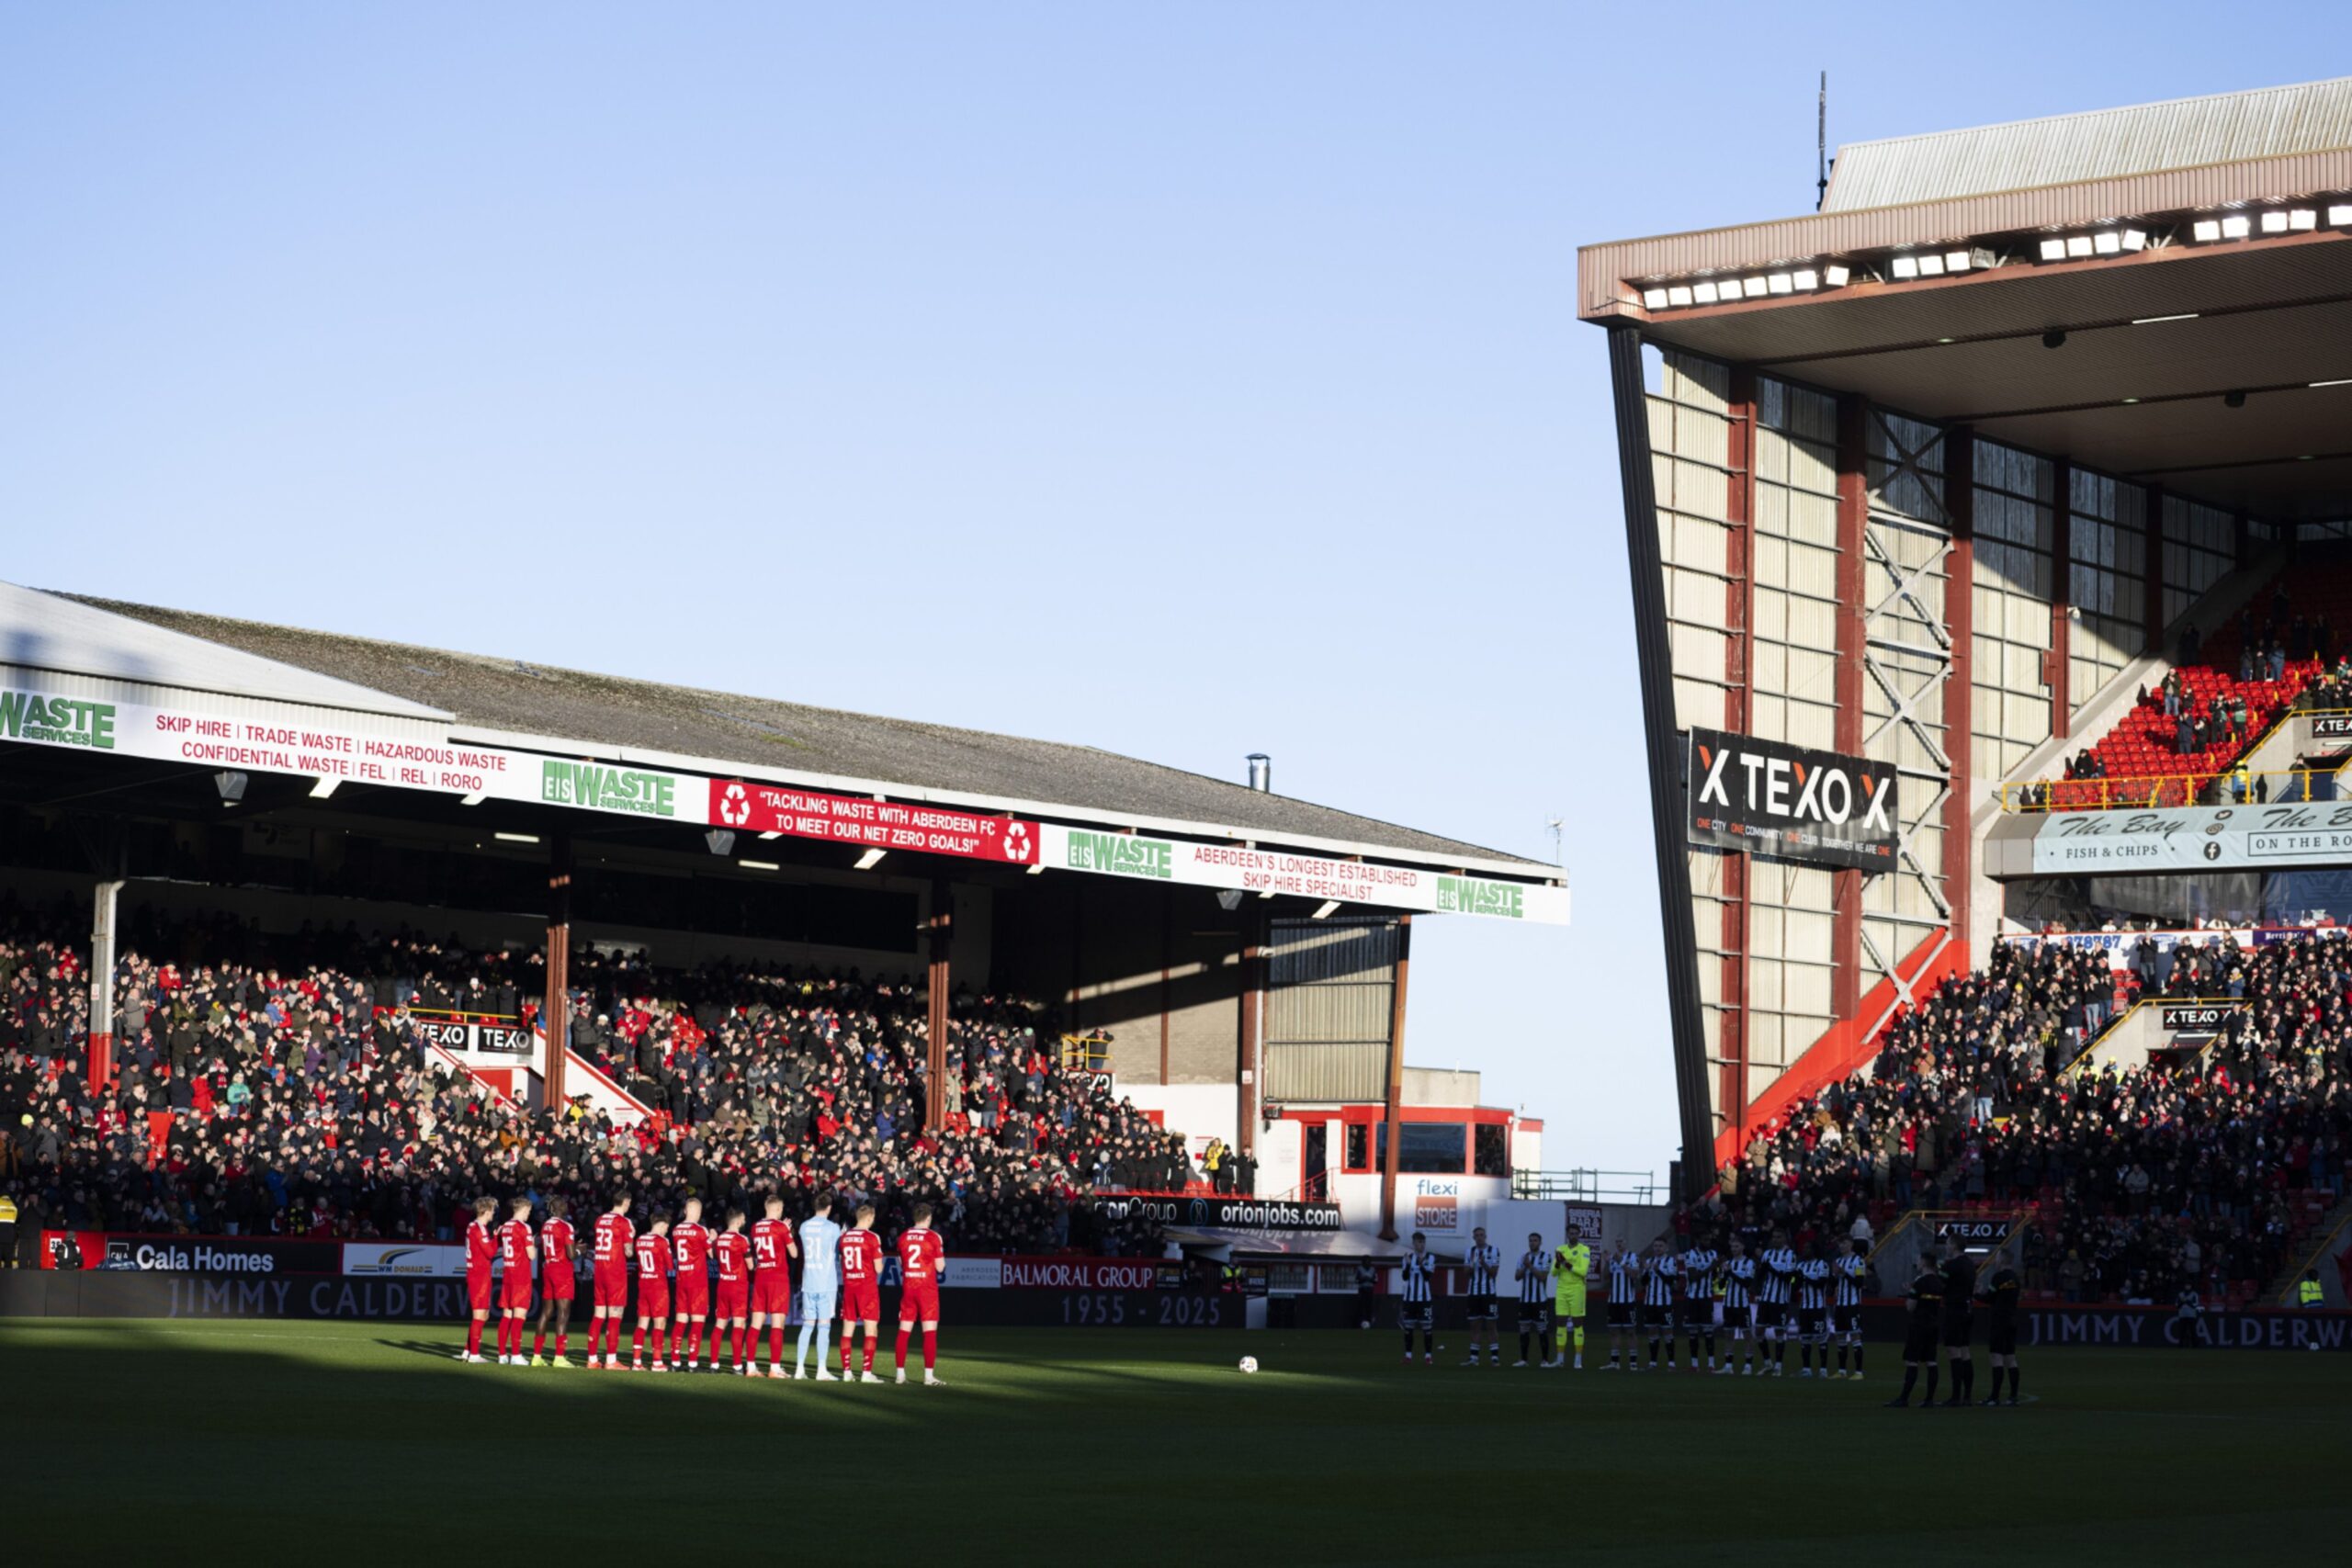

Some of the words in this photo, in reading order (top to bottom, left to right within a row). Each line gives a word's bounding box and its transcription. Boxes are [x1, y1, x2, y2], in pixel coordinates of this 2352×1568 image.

[0, 691, 116, 749] WASTE
[22, 726, 90, 746] SERVICES
[156, 715, 191, 733] SKIP
[197, 720, 231, 738] HIRE
[246, 726, 297, 747] TRADE
[301, 732, 352, 753] WASTE
[366, 740, 454, 765] HAZARDOUS
[458, 751, 506, 771] WASTE
[182, 741, 293, 769] CONFIDENTIAL
[298, 755, 348, 774] WASTE
[360, 762, 386, 780] FEL
[401, 768, 428, 784] REL
[441, 773, 482, 790] RORO
[543, 770, 571, 801] EIS
[573, 764, 674, 816] WASTE
[1699, 745, 1730, 807] X
[1740, 752, 1852, 825] TEXO
[600, 797, 655, 814] SERVICES
[831, 800, 875, 820] WASTE
[877, 806, 909, 825] WITH
[911, 813, 977, 835] ABERDEEN
[979, 819, 995, 836] FC
[2262, 807, 2317, 829] The
[775, 814, 793, 830] TO
[796, 817, 831, 835] MEET
[833, 821, 861, 839] OUR
[864, 827, 889, 842] NET
[891, 829, 925, 847] ZERO
[1697, 818, 1711, 829] ONE
[1713, 819, 1726, 831] CITY
[1731, 823, 1744, 835] ONE
[1746, 825, 1782, 840] COMMUNITY
[1787, 832, 1800, 843] ONE
[1802, 833, 1818, 846] CLUB
[1822, 837, 1854, 851] TOGETHER
[1854, 842, 1864, 852] WE
[1865, 843, 1877, 855] ARE
[1878, 845, 1891, 857] ONE
[2059, 816, 2111, 837] The
[2120, 814, 2186, 840] Bay
[1069, 838, 1091, 867] EIS
[1092, 833, 1171, 878] WASTE
[2066, 847, 2097, 859] FISH
[2102, 847, 2111, 857] &
[2116, 845, 2158, 857] CHIPS
[2256, 839, 2278, 849] ON
[2289, 837, 2321, 848] THE
[1114, 862, 1156, 876] SERVICES
[1194, 846, 1275, 870] ABERDEEN'S
[1279, 857, 1335, 877] LONGEST
[1340, 864, 1418, 887] ESTABLISHED
[1243, 872, 1272, 887] SKIP
[1274, 875, 1302, 893] HIRE
[1306, 879, 1374, 900] SPECIALIST
[1437, 883, 1457, 910] EIS
[1457, 879, 1523, 918] WASTE
[1475, 903, 1511, 917] SERVICES
[2178, 1010, 2218, 1023] TEXO
[483, 1029, 530, 1049] TEXO
[1418, 1179, 1458, 1195] flexi
[1220, 1200, 1340, 1229] orionjobs.com
[1417, 1206, 1456, 1226] STORE
[595, 1228, 613, 1251] 33
[1951, 1223, 1992, 1236] TEXO
[138, 1245, 190, 1270] Cala
[194, 1245, 274, 1272] Homes
[502, 1236, 514, 1258] 16
[677, 1239, 688, 1263] 6
[754, 1235, 775, 1260] 24
[805, 1236, 821, 1259] 31
[843, 1246, 863, 1270] 81
[908, 1244, 922, 1269] 2
[378, 1265, 392, 1273] WM
[638, 1249, 655, 1273] 10
[719, 1249, 731, 1272] 4
[1002, 1263, 1091, 1287] BALMORAL
[1097, 1267, 1153, 1288] GROUP
[167, 1278, 292, 1318] JIMMY
[310, 1280, 540, 1317] CALDERW
[1061, 1294, 1125, 1324] 1955
[1159, 1295, 1220, 1325] 2025
[2029, 1314, 2145, 1346] JIMMY
[2164, 1316, 2352, 1348] CALDERW
